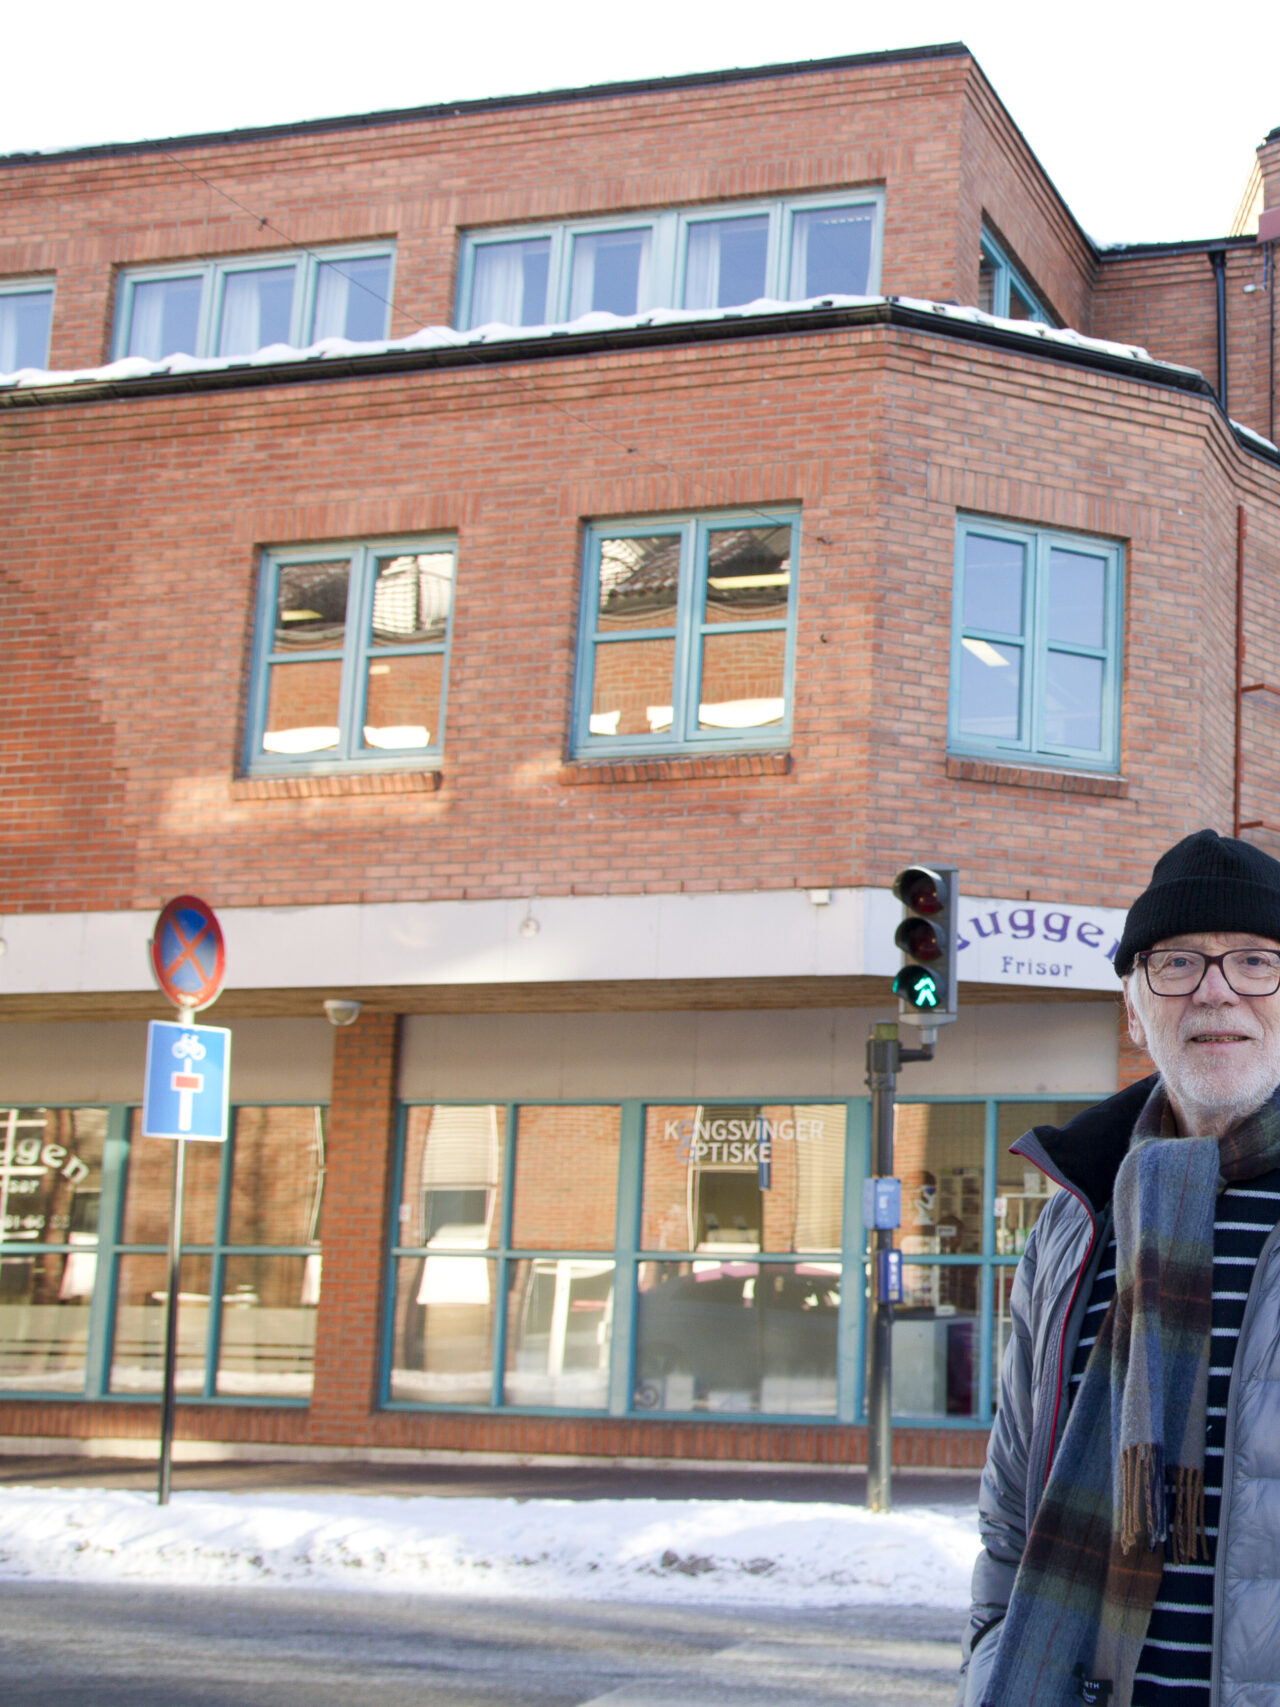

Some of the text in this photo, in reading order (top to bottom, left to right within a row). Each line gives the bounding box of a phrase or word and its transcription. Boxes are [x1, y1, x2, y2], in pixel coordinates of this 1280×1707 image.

[957, 908, 1122, 961] ugge
[663, 1119, 825, 1141] KONGSVINGER
[676, 1142, 772, 1163] OPTISKE
